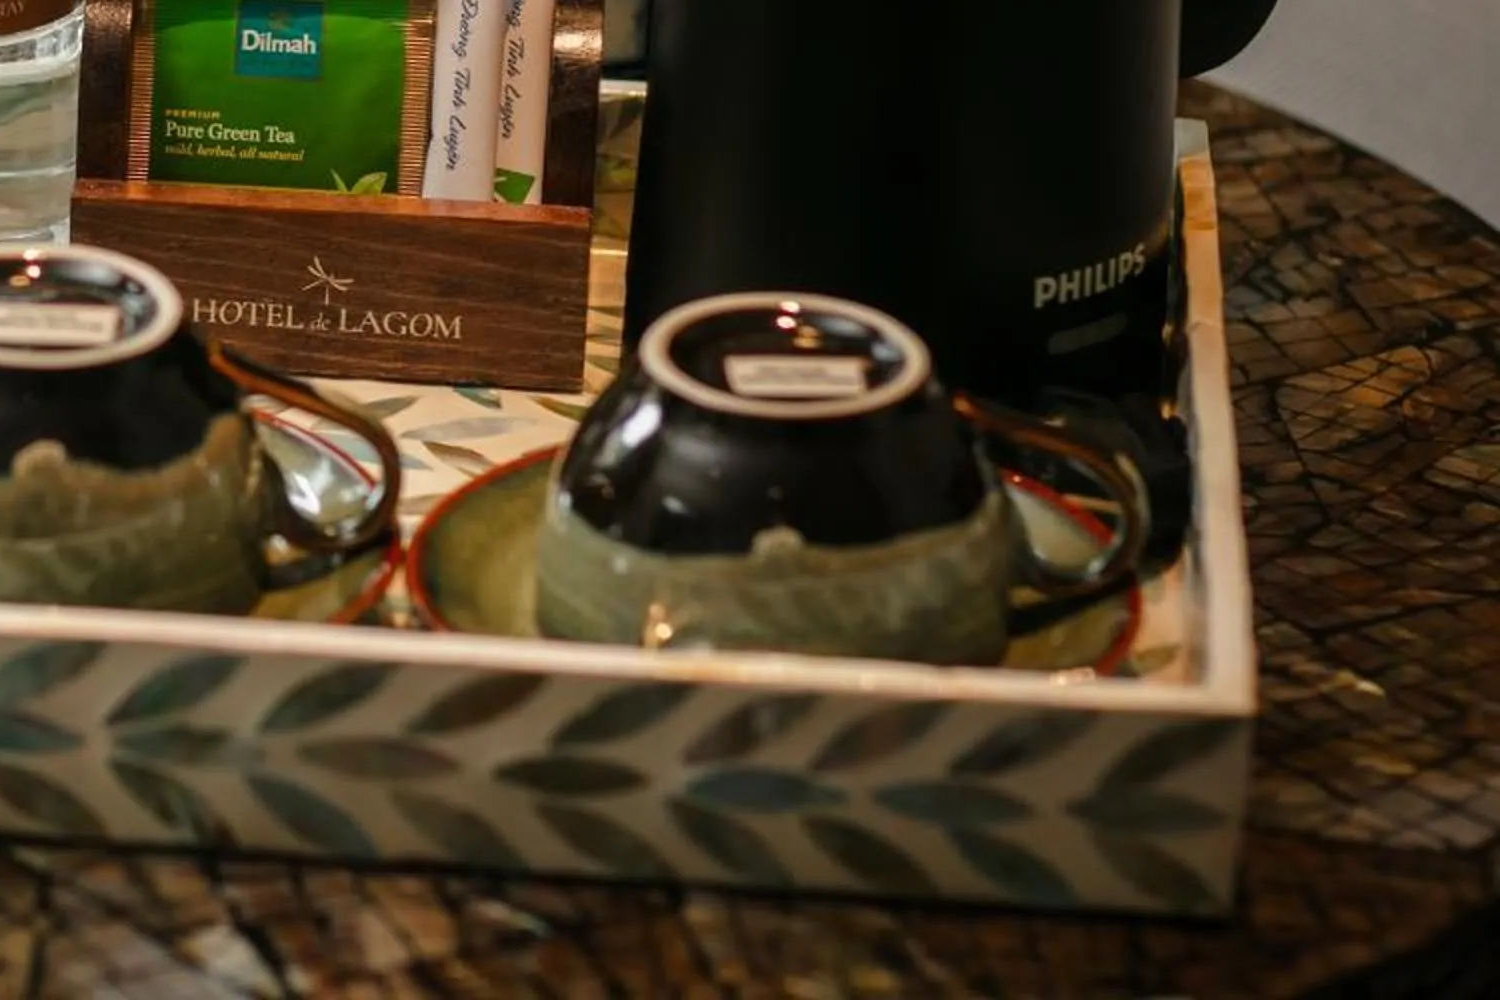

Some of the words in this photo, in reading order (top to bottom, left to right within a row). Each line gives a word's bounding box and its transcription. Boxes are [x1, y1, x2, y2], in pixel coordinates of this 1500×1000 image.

[241, 29, 318, 55] Dilmah
[164, 108, 221, 119] PREMIUM
[165, 119, 205, 139] Pure
[208, 123, 261, 142] Green
[264, 125, 296, 144] Tea
[258, 149, 305, 162] natural
[1034, 242, 1147, 309] PHILIPS
[192, 297, 304, 330] HOTEL
[311, 312, 333, 332] de
[339, 308, 464, 340] LAGOM
